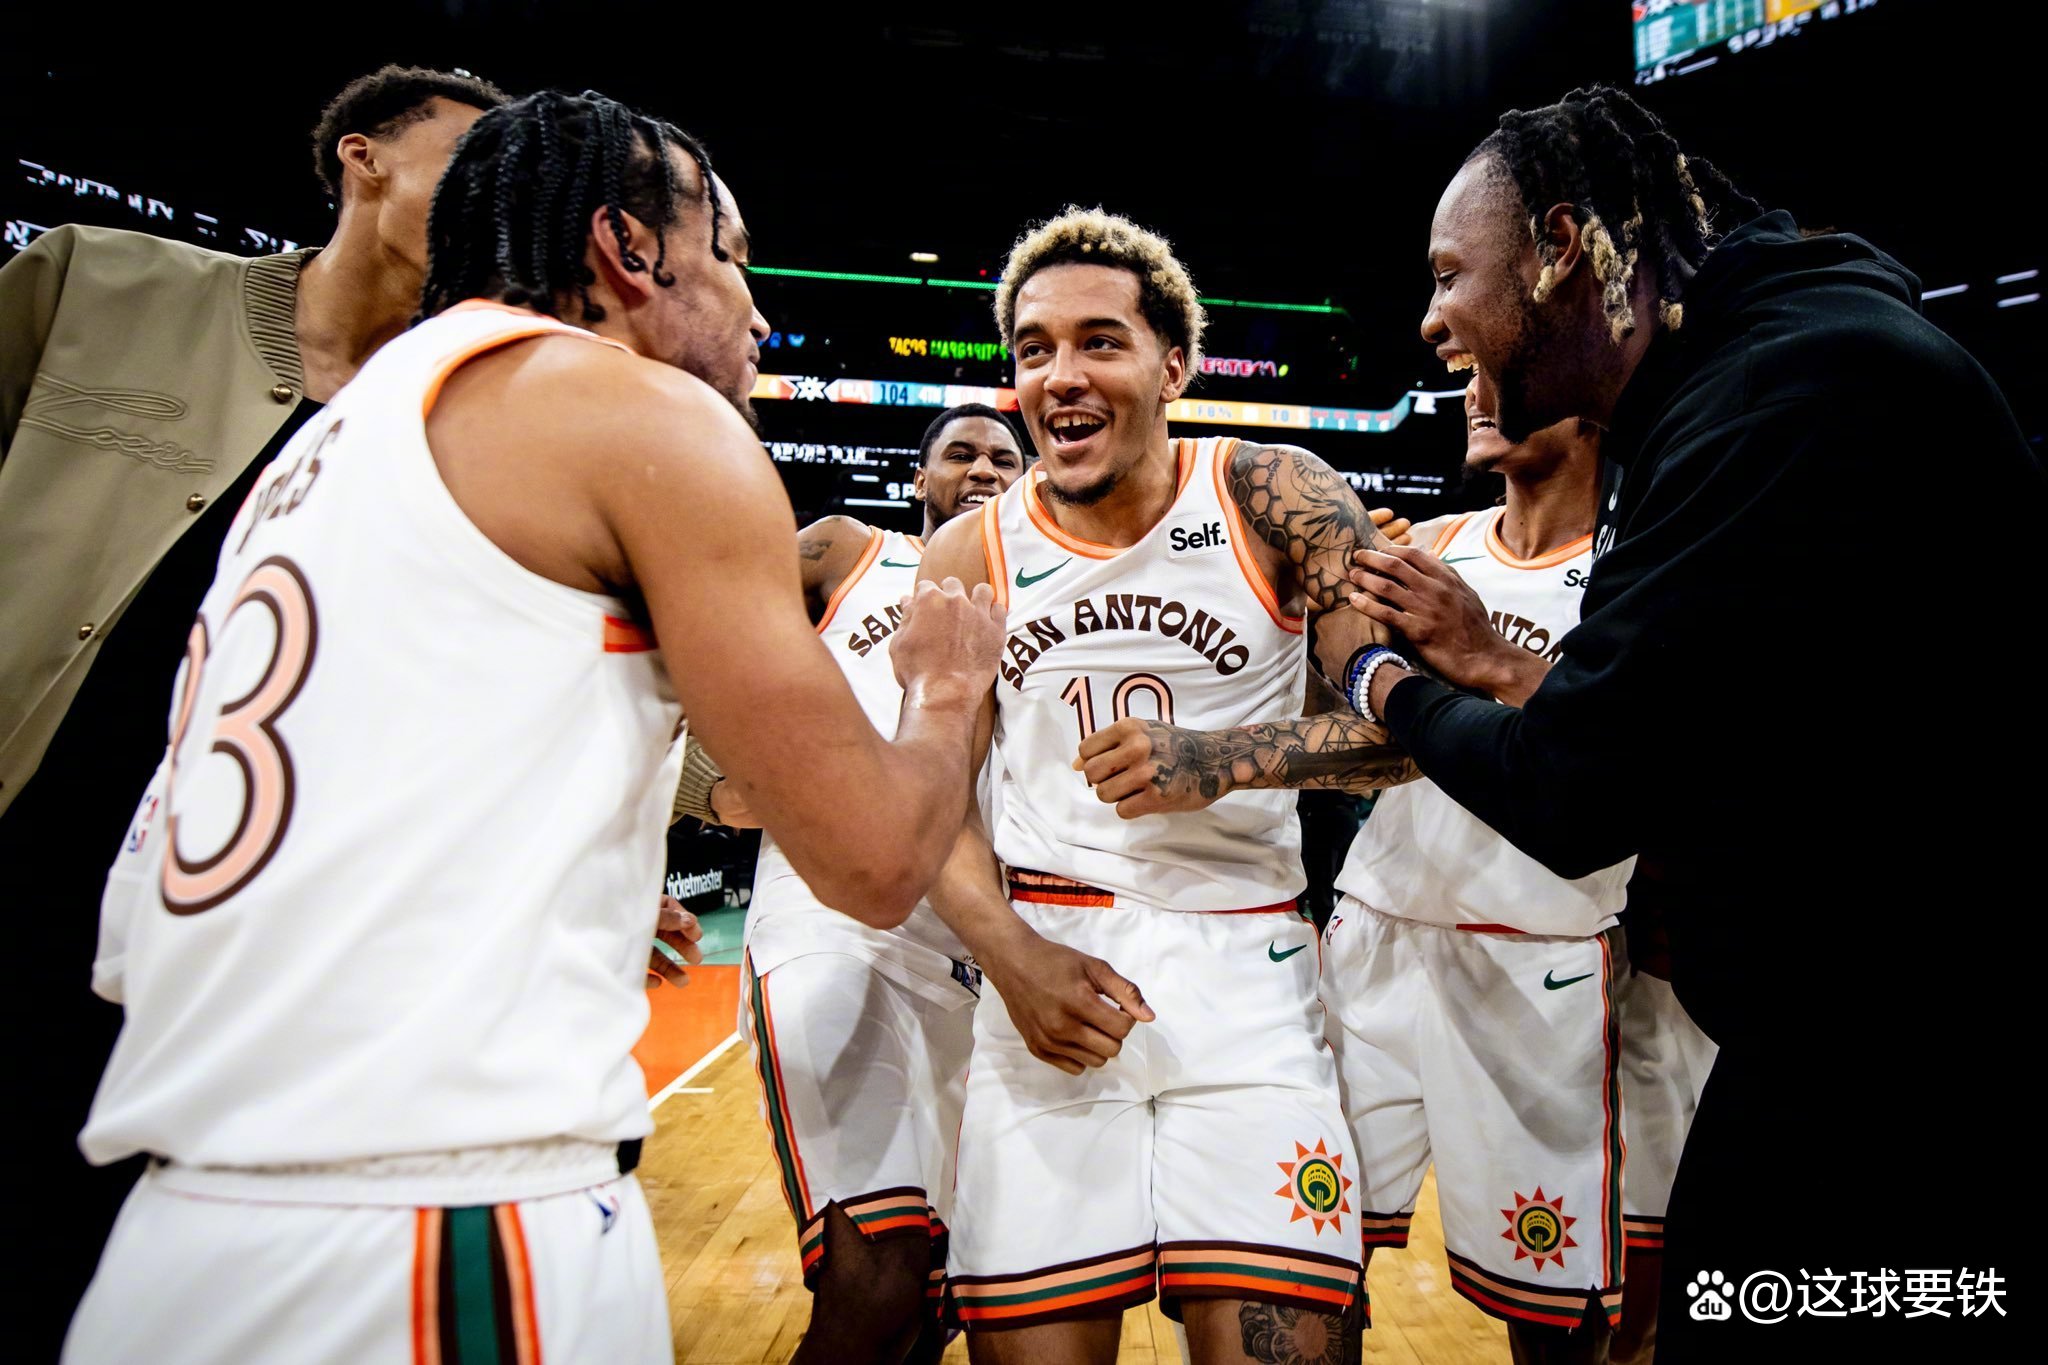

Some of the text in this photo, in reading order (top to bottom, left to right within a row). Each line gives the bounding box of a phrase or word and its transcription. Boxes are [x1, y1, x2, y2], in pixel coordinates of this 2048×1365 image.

[888, 336, 928, 357] TACOS
[880, 382, 909, 405] 104
[1169, 521, 1228, 552] Self.
[1563, 568, 1591, 589] Se
[1001, 593, 1250, 692] SAN ANTONIO
[666, 868, 723, 901] ticketmaster
